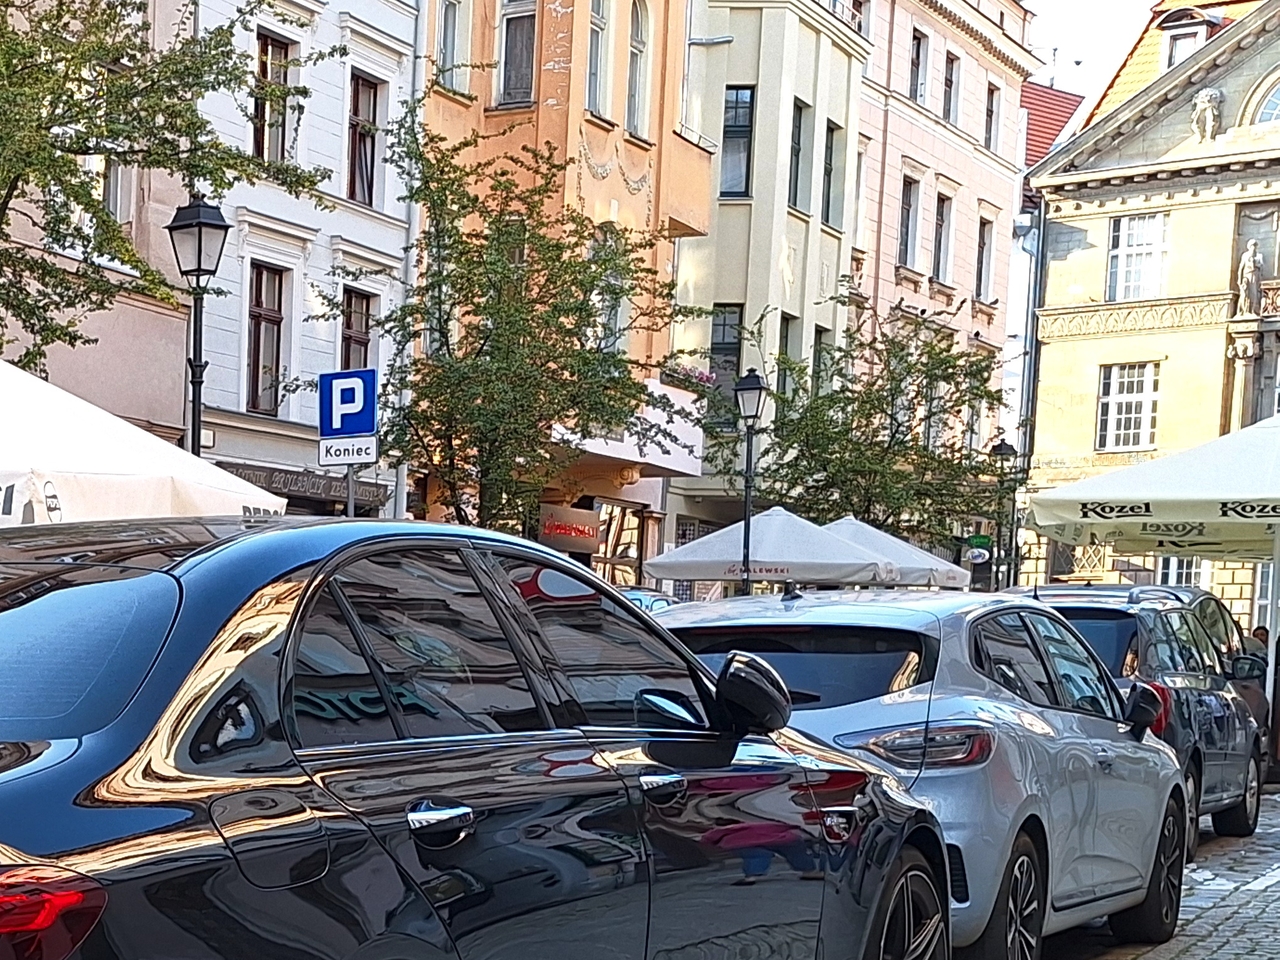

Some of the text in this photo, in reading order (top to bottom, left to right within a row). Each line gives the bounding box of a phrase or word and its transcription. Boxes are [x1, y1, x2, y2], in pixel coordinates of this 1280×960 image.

[331, 377, 364, 430] P
[324, 443, 372, 459] Koniec
[1079, 501, 1154, 519] Kozel
[1220, 501, 1280, 519] Koze
